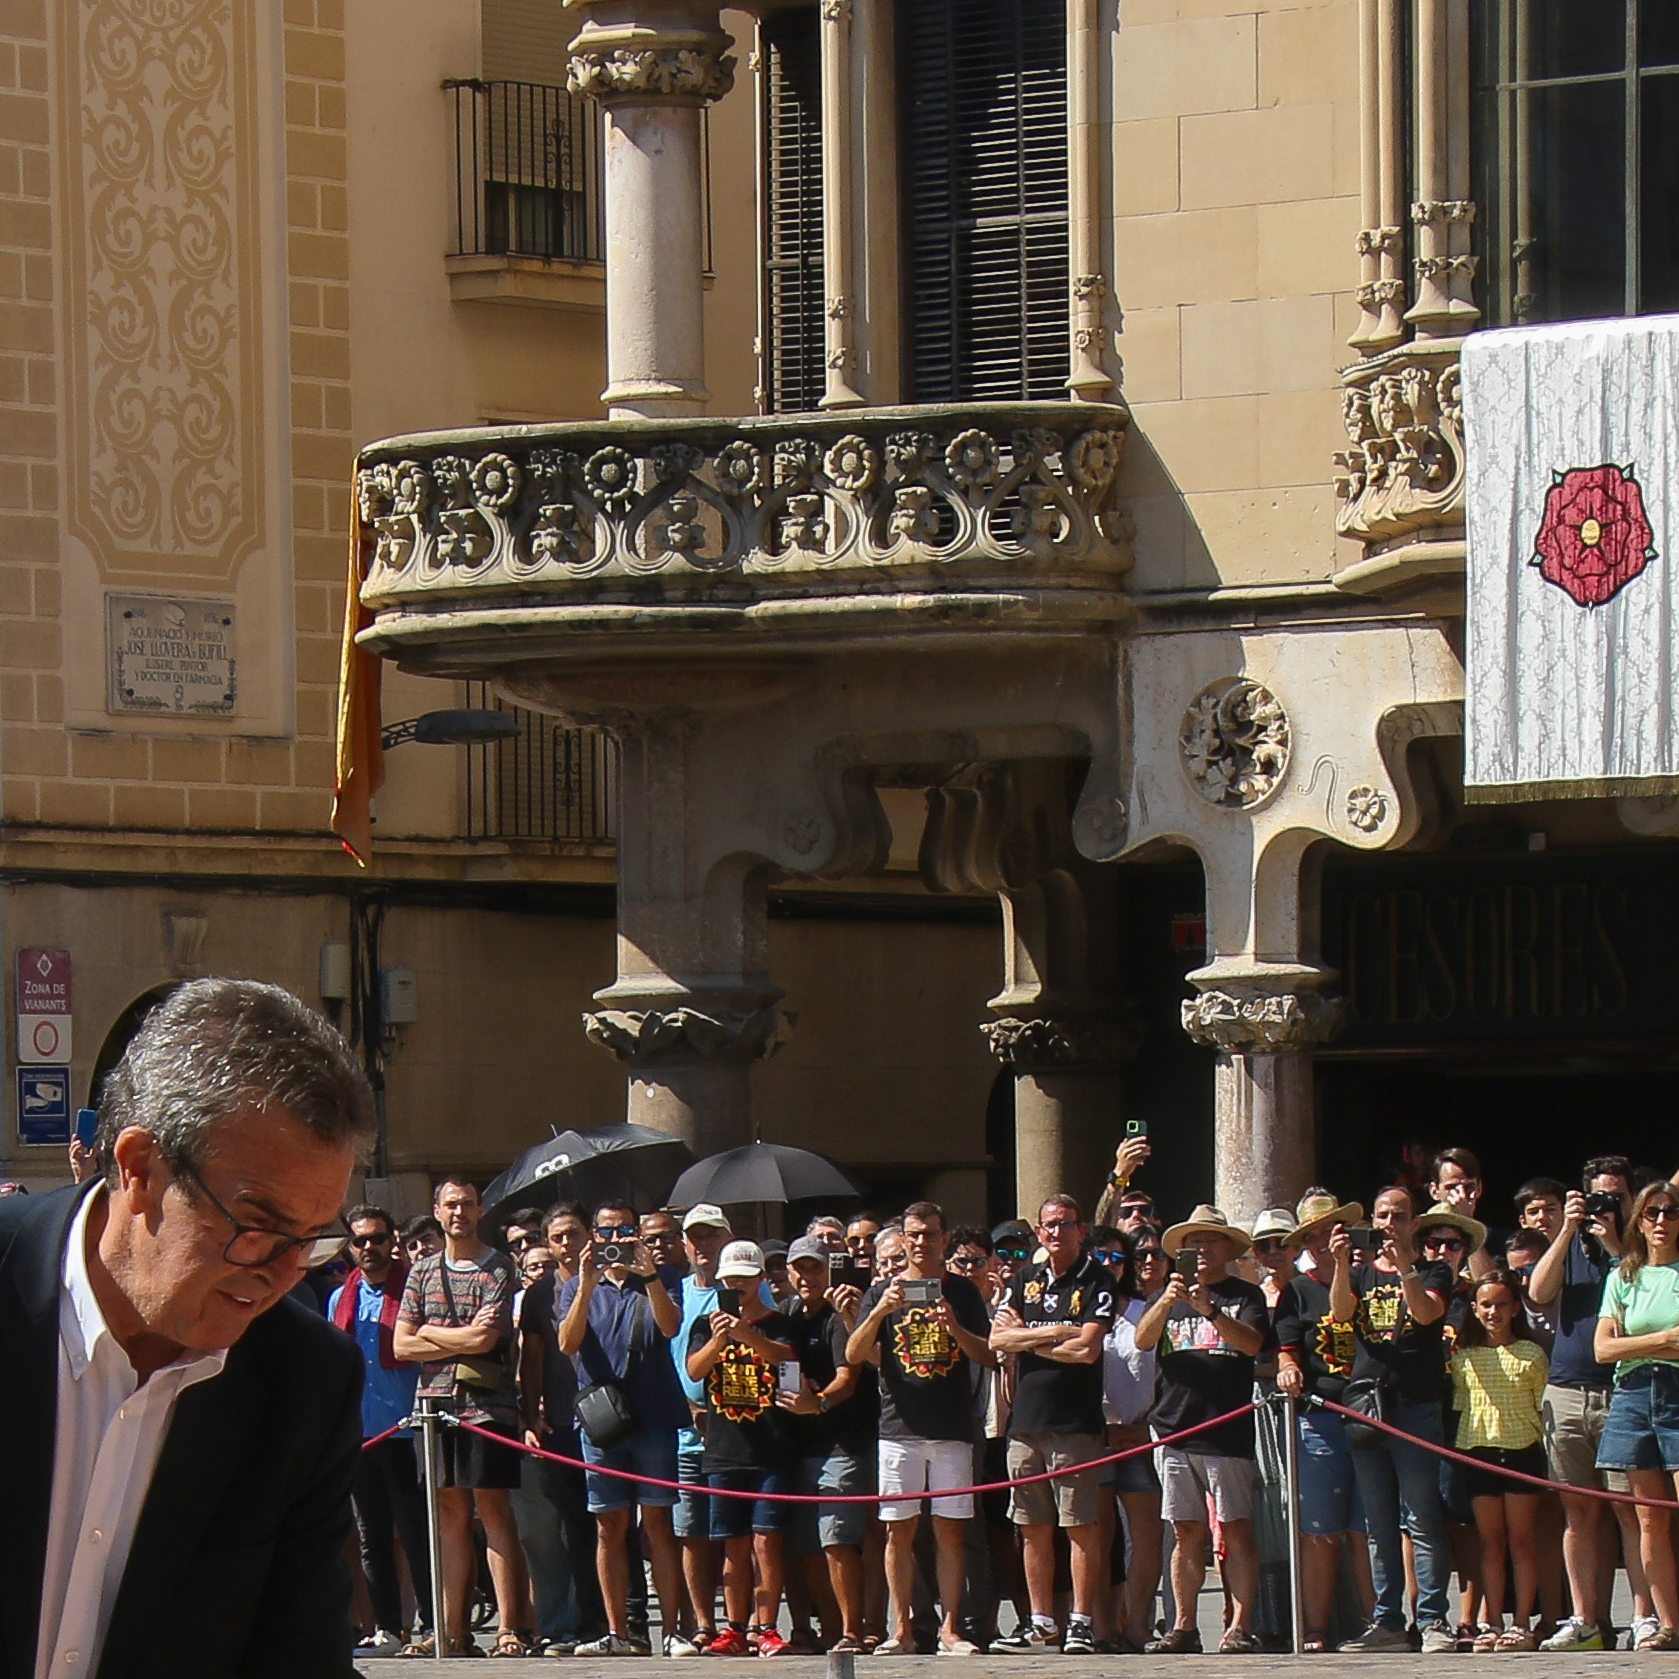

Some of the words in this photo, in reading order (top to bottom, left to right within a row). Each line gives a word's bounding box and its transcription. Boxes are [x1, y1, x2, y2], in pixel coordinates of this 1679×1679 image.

[1341, 882, 1630, 1023] CESORES
[24, 981, 50, 995] ZONA
[53, 983, 66, 995] DE
[1095, 1291, 1113, 1317] 2
